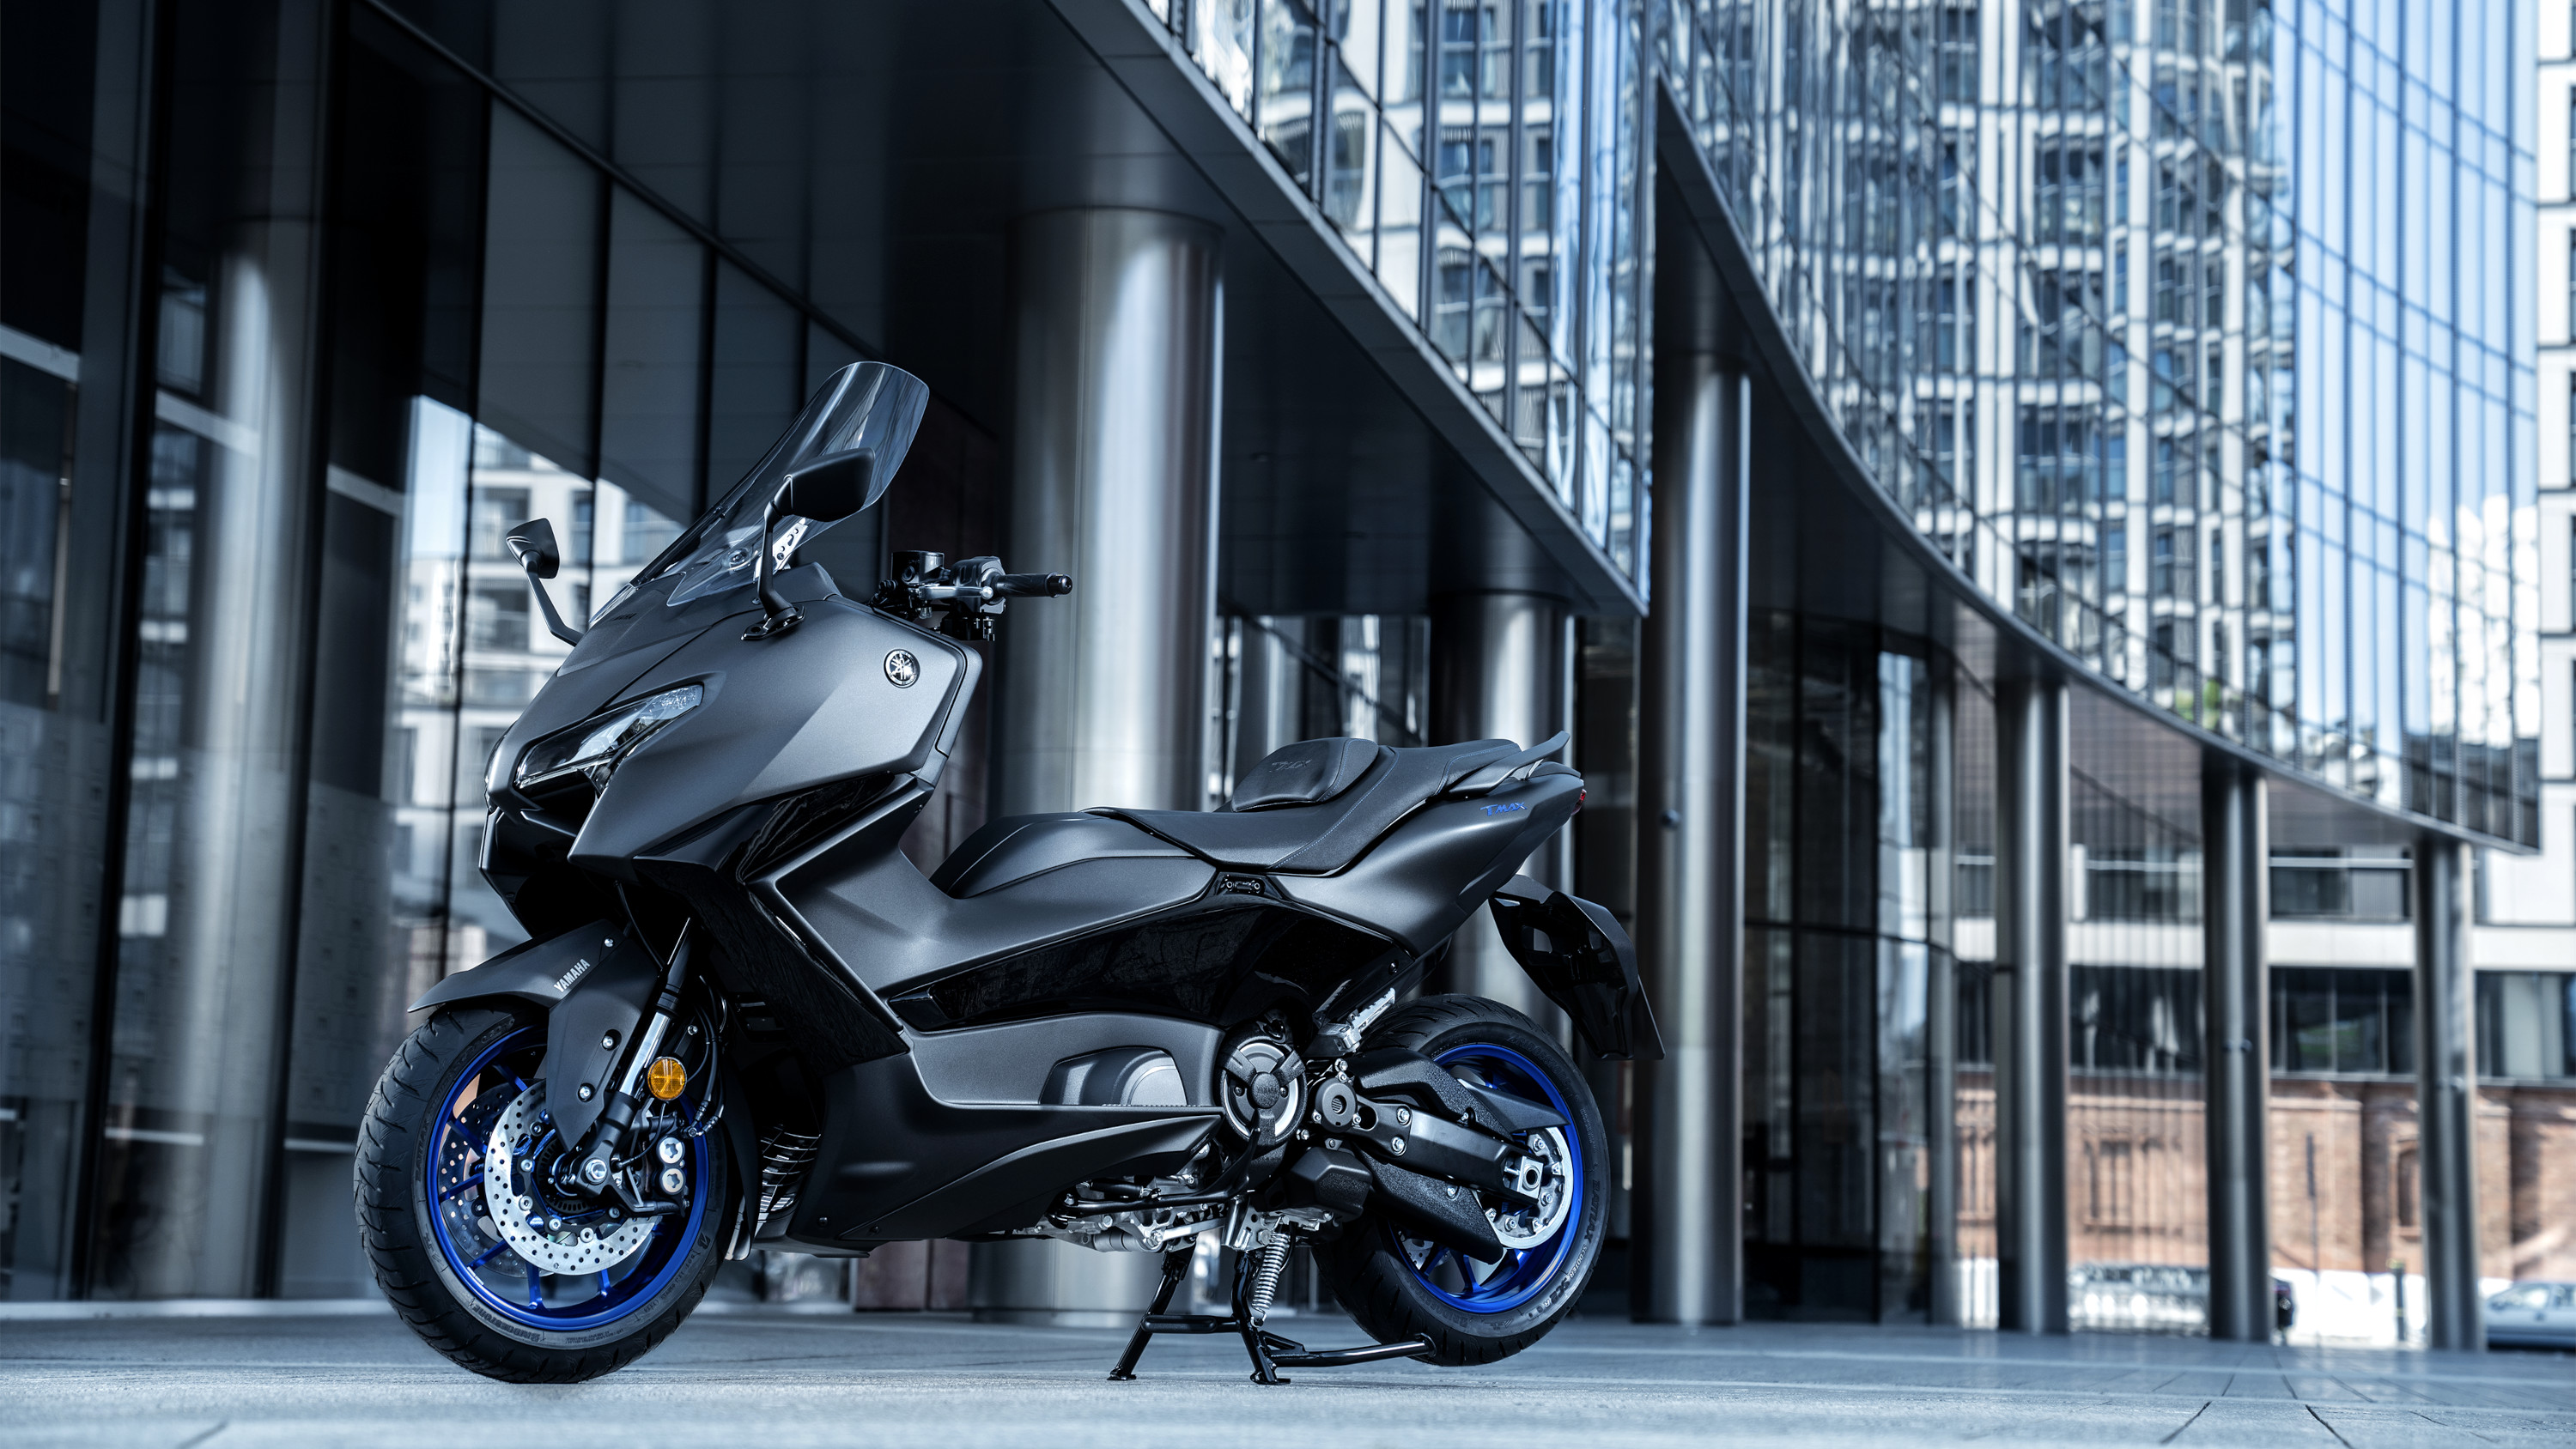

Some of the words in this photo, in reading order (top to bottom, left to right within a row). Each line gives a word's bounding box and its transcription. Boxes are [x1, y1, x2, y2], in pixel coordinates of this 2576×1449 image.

[1479, 801, 1528, 816] TMAX
[553, 958, 591, 992] YAMAHA
[1585, 1179, 1601, 1243] BATTLAX
[1569, 1244, 1588, 1279] SCOOTER
[471, 1304, 541, 1342] BRIDGESTONE
